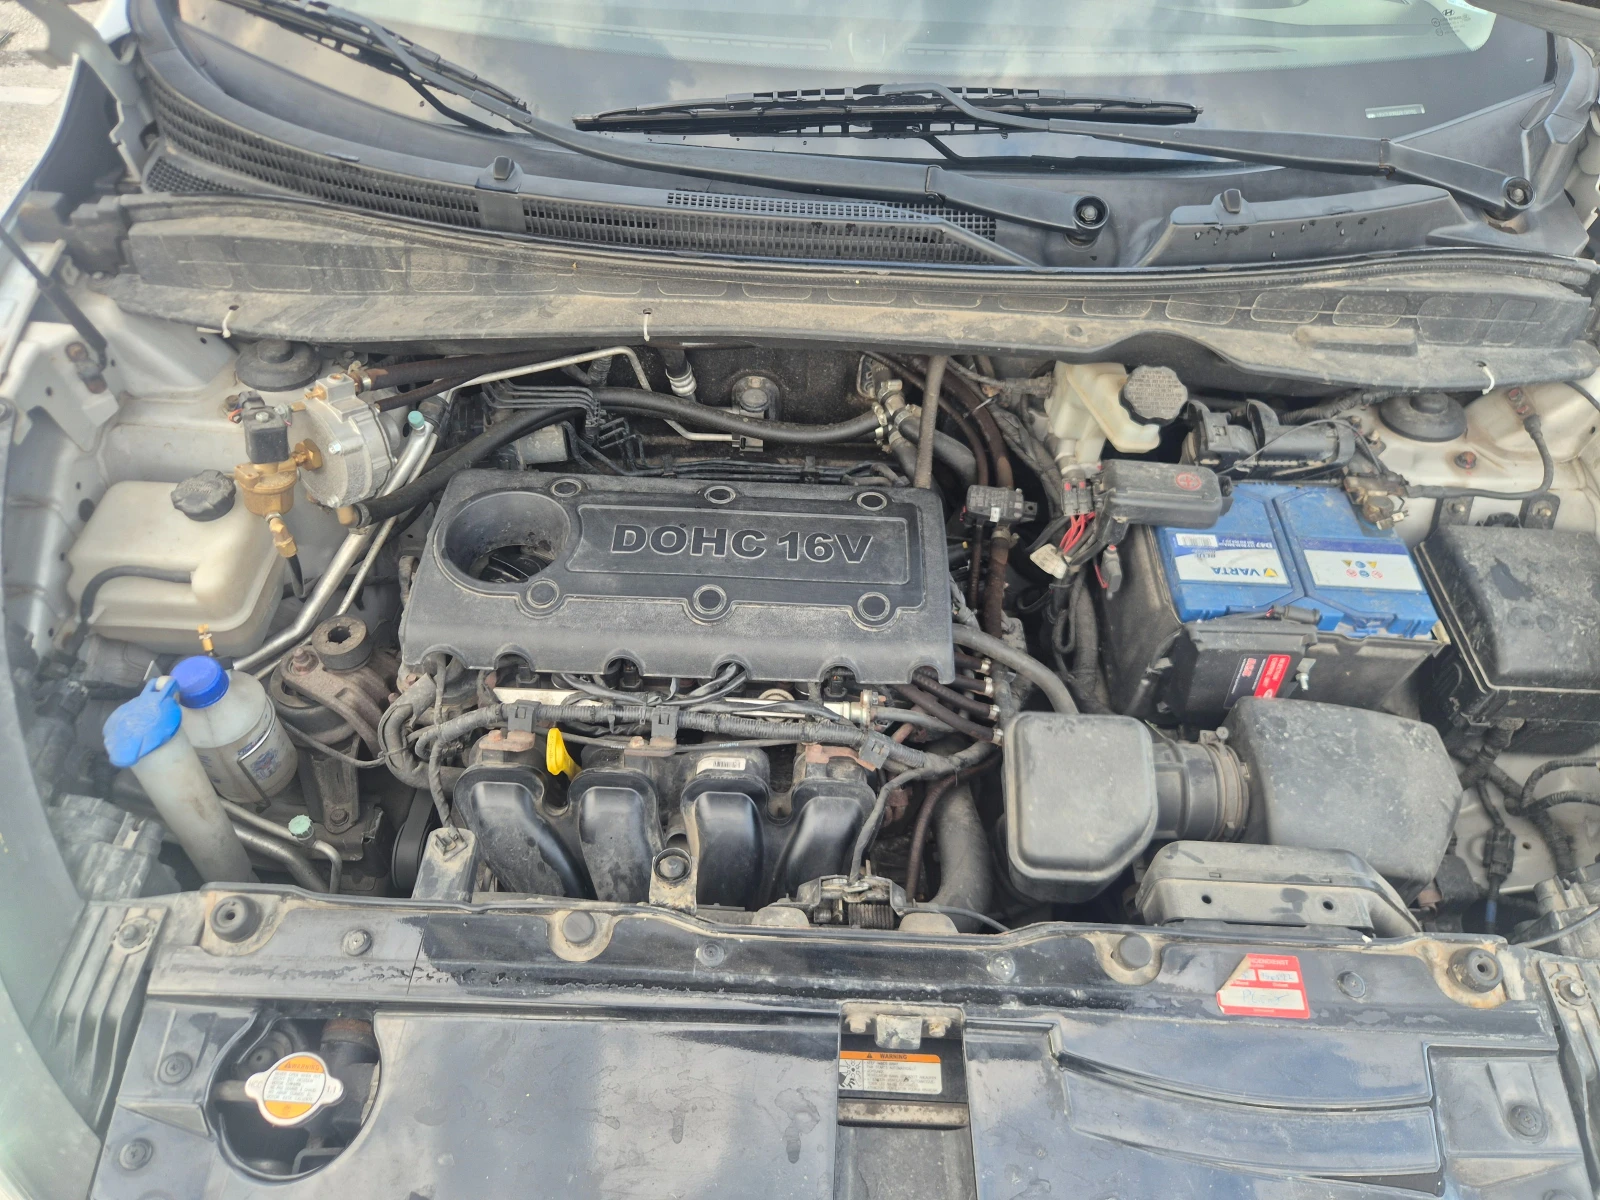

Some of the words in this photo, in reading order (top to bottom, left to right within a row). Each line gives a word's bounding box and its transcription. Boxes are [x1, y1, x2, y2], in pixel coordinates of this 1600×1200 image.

[610, 524, 767, 559] DOHC
[777, 531, 873, 563] 16V
[1211, 566, 1260, 577] VARTA
[291, 1063, 320, 1071] WARNING
